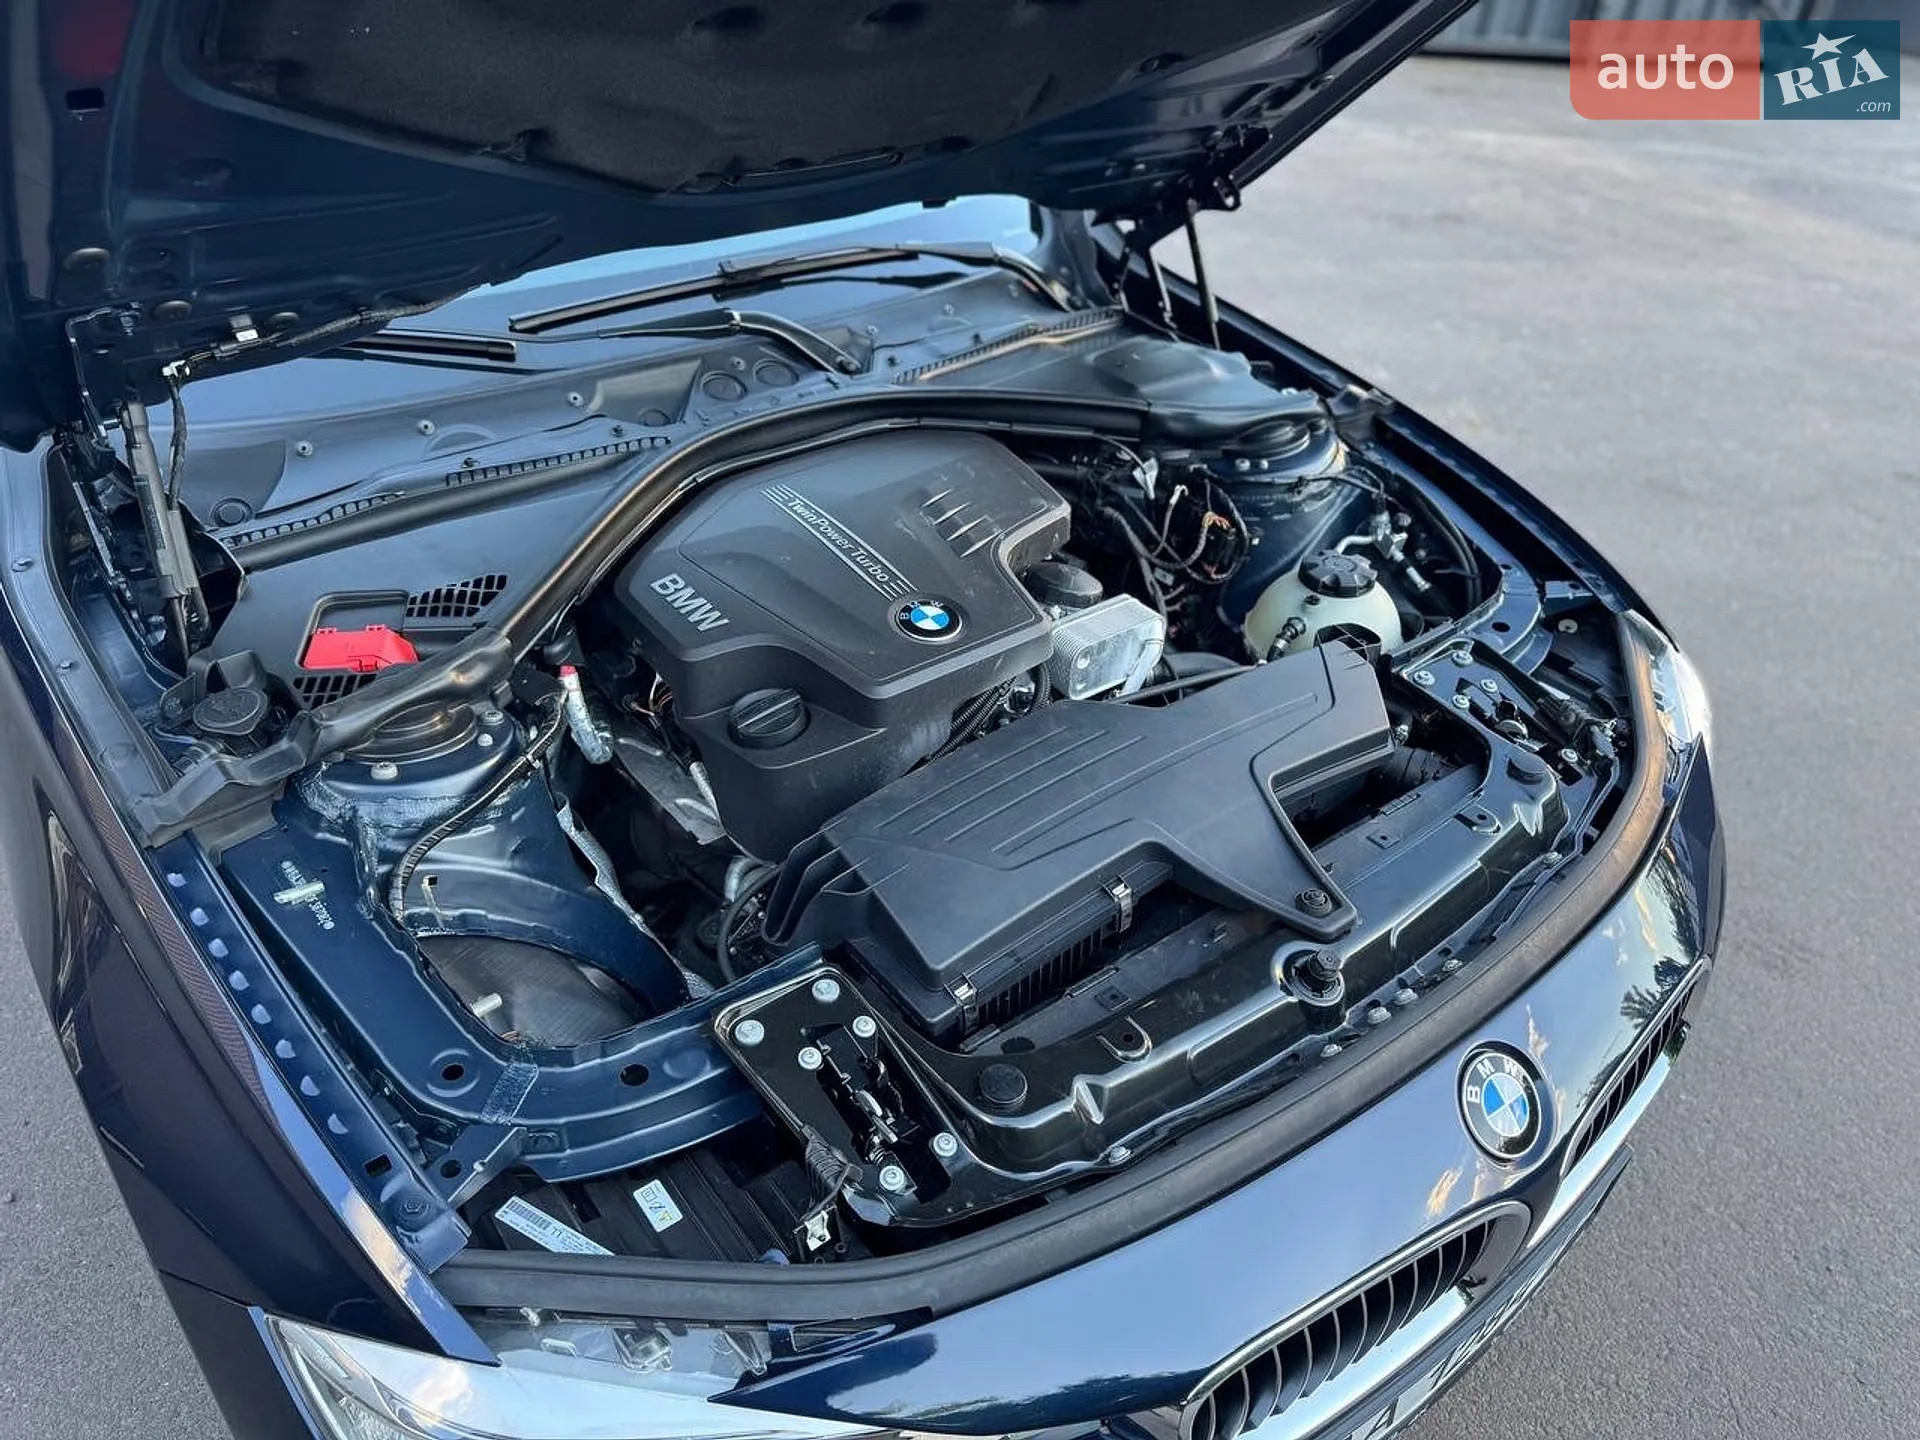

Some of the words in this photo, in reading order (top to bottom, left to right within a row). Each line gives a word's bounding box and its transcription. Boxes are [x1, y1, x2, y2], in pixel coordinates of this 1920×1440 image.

[787, 499, 854, 549] TwinPower
[851, 548, 889, 581] Turbo
[650, 573, 730, 631] BMW
[1467, 1058, 1522, 1104] BMW
